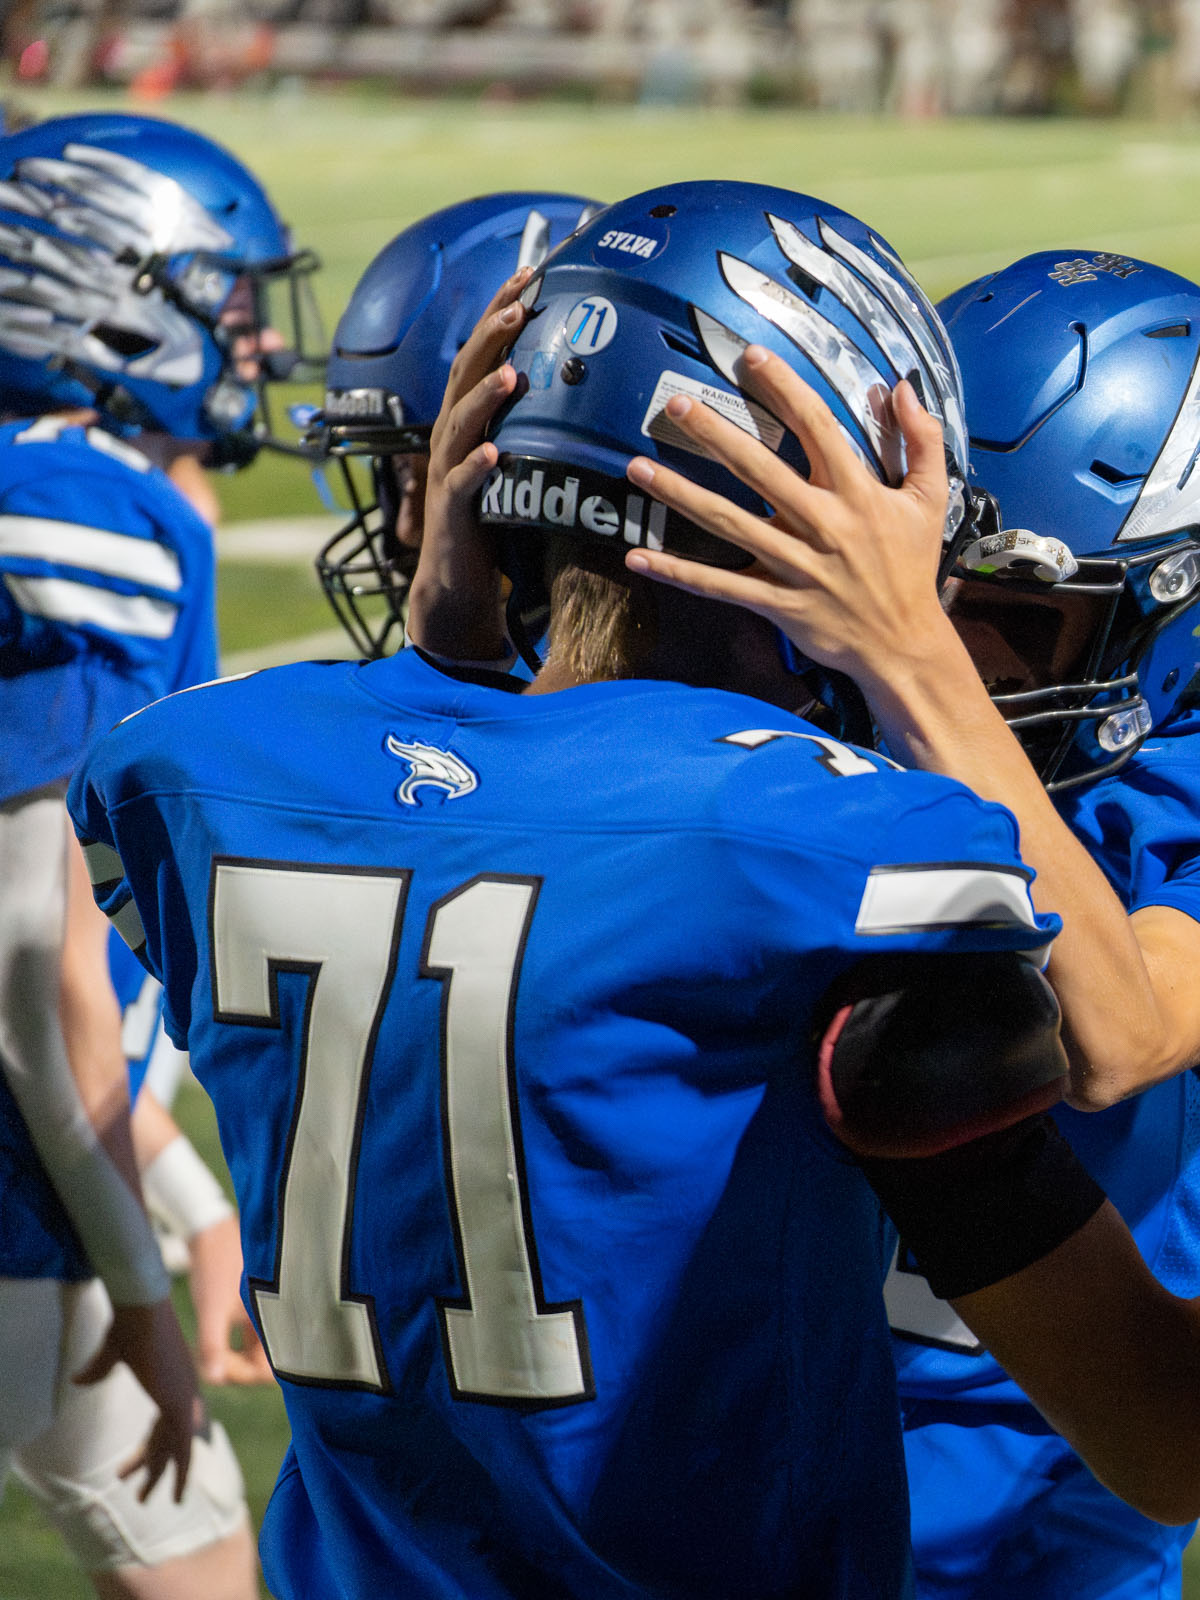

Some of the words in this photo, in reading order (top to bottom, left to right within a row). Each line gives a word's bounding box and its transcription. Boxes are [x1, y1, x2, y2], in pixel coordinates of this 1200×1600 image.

[597, 230, 658, 259] SYLVA
[571, 302, 608, 347] 71
[481, 466, 667, 552] Riddell
[210, 855, 595, 1407] 71
